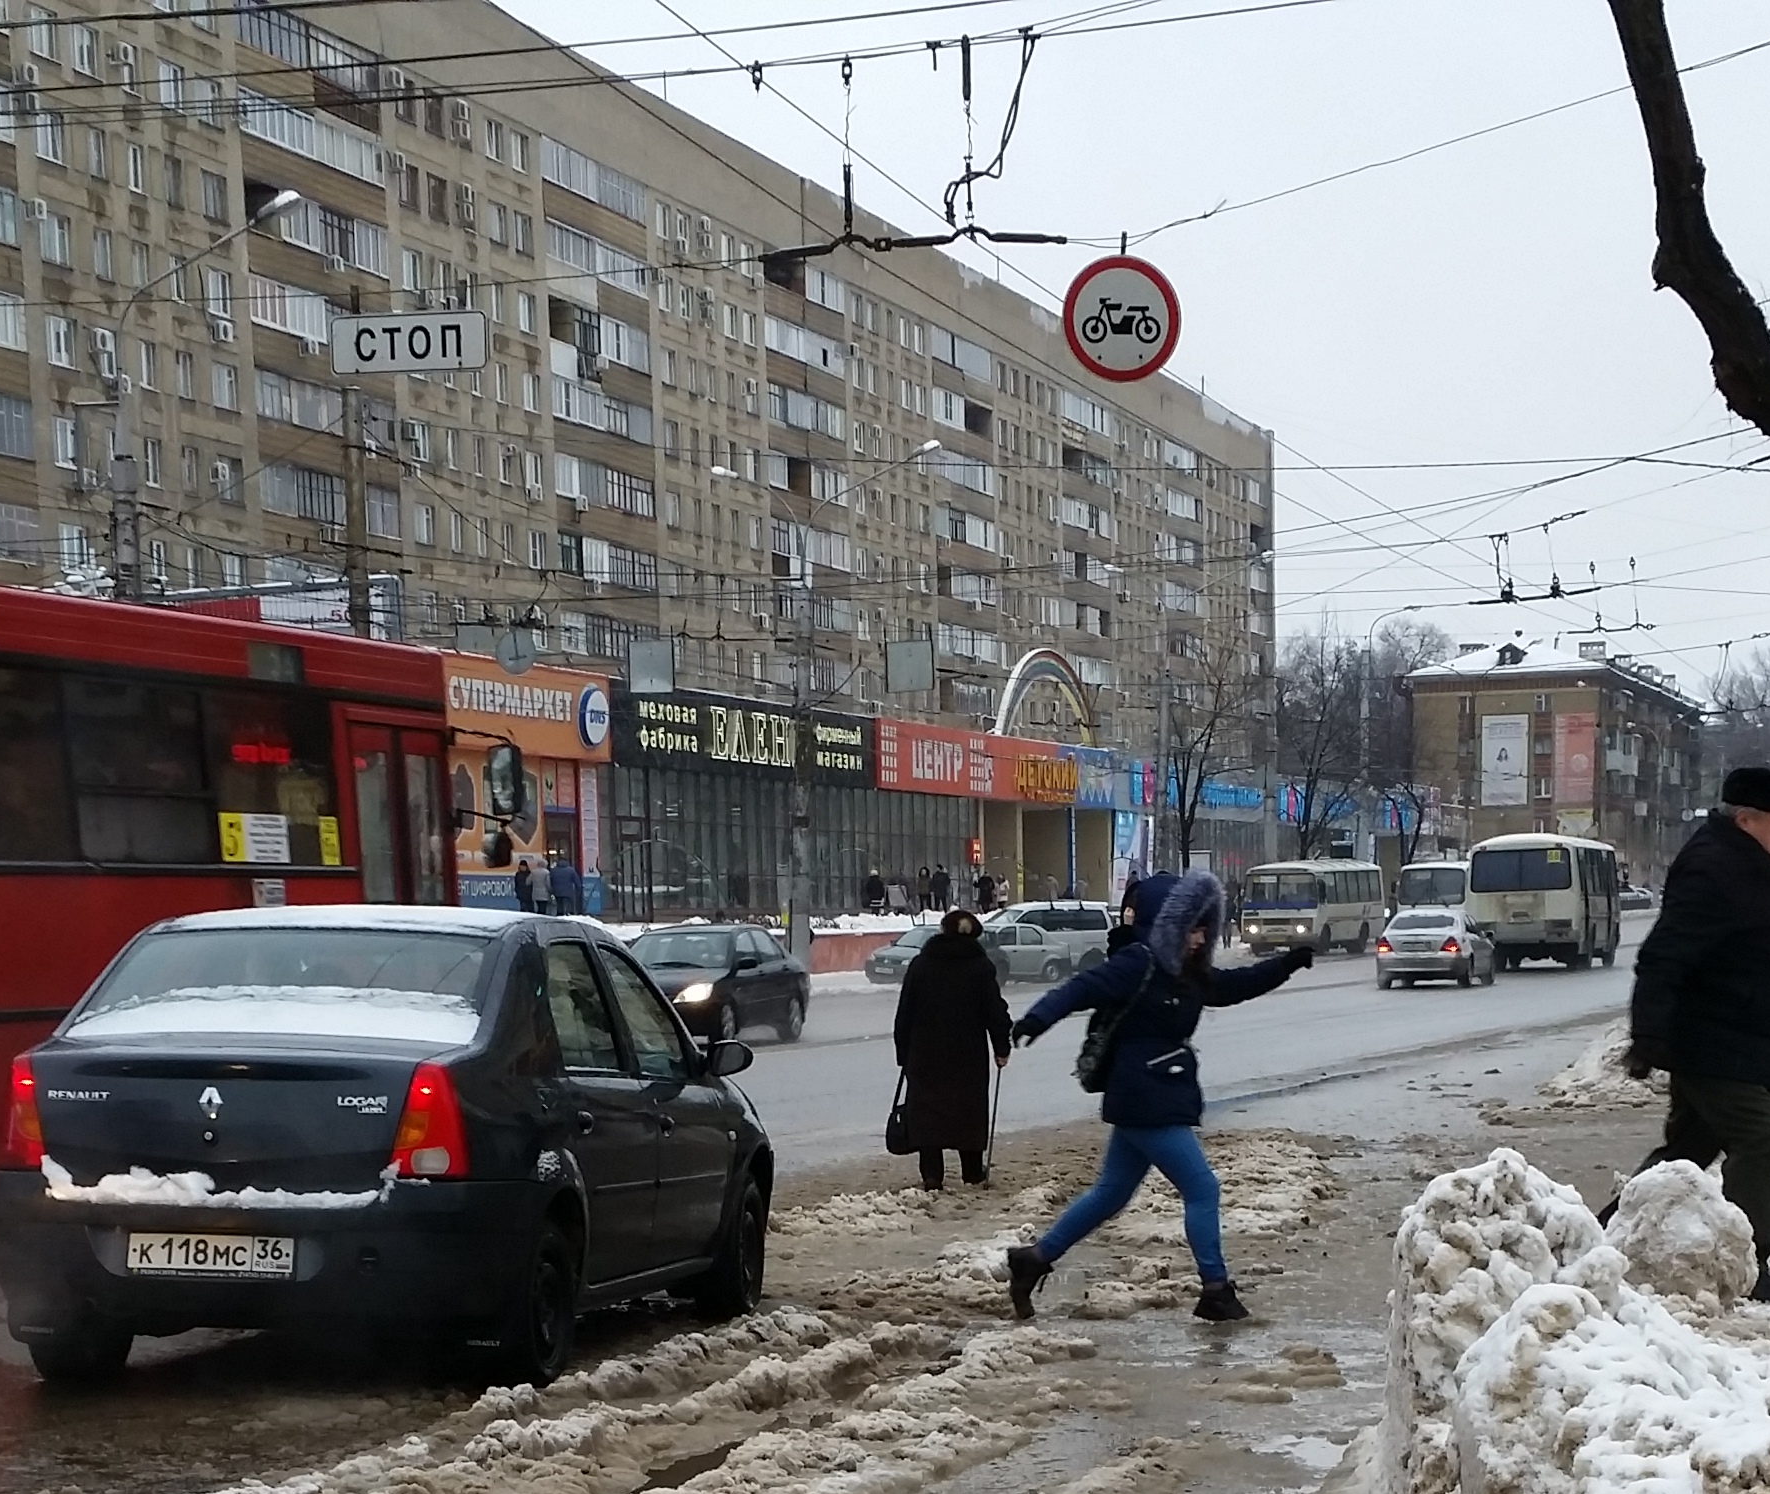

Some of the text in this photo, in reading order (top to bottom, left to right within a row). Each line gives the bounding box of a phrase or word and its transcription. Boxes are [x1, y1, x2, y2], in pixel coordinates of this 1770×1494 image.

[355, 324, 462, 362] СТОП
[448, 675, 573, 723] СУПЕРМАРКЕТ
[639, 700, 697, 725] меховая
[637, 724, 699, 754] фабрика
[816, 749, 863, 771] магазин
[911, 738, 963, 783] ЦЕНТР
[48, 1089, 110, 1100] RENAULT
[256, 1239, 283, 1260] 36
[254, 1260, 275, 1269] RUS
